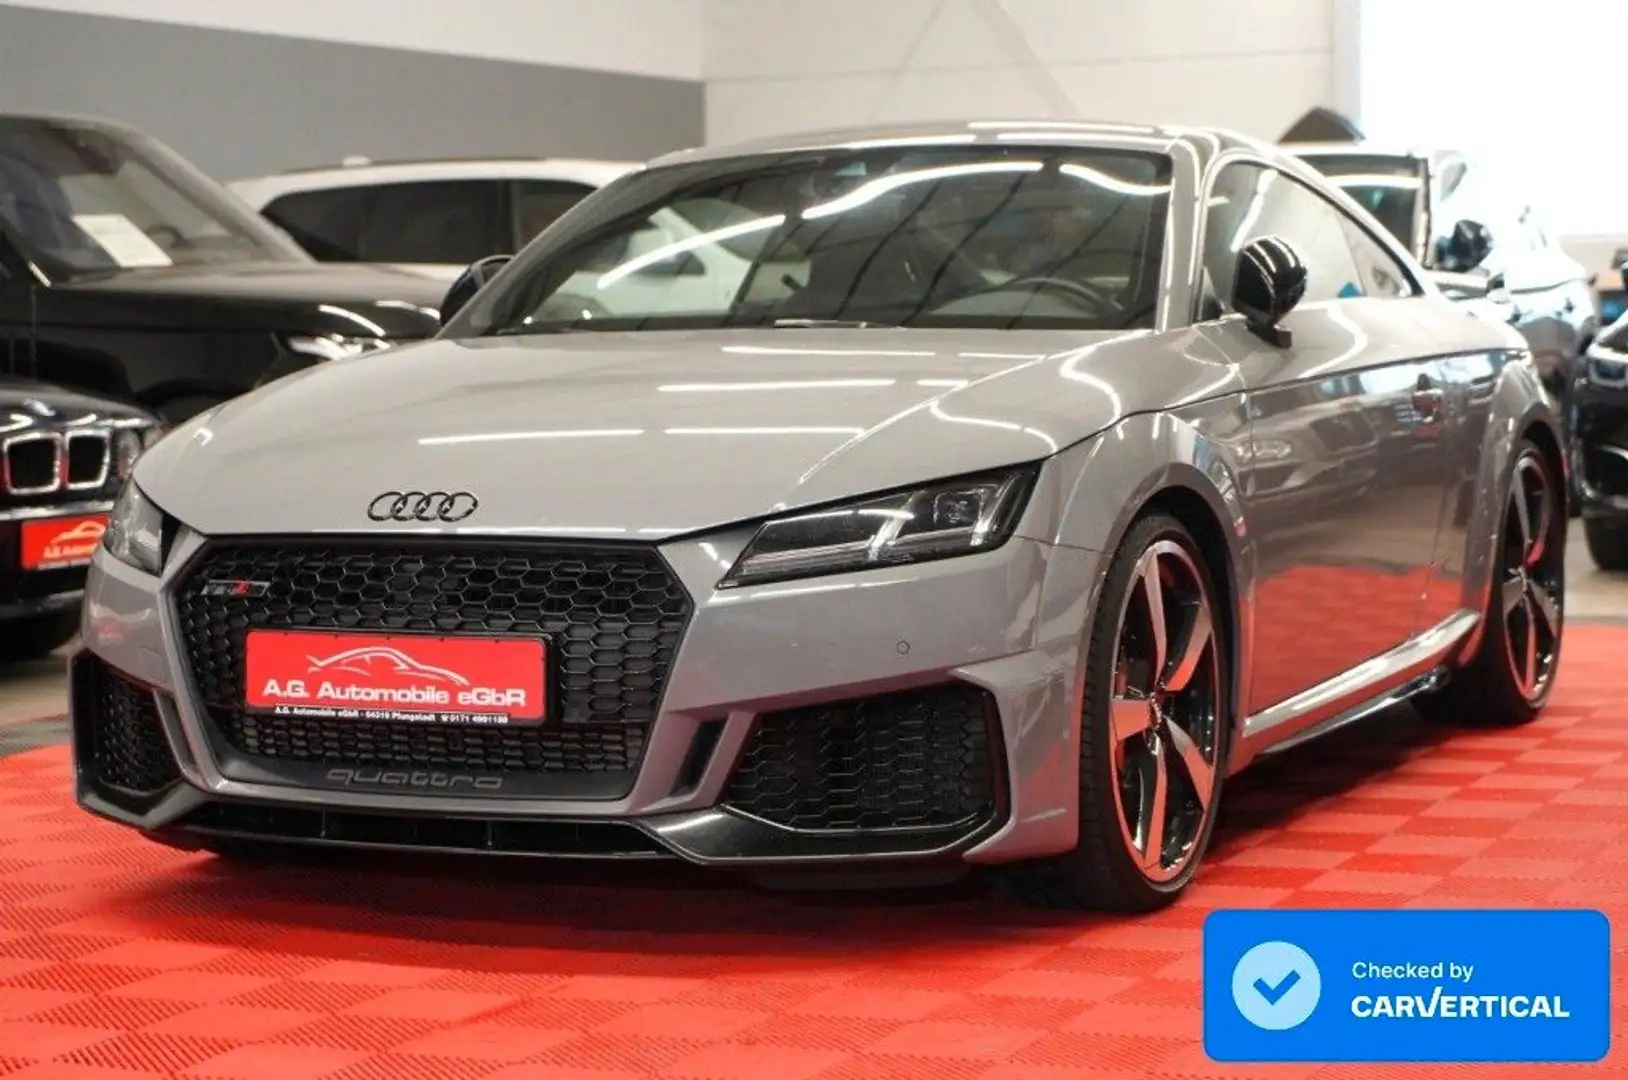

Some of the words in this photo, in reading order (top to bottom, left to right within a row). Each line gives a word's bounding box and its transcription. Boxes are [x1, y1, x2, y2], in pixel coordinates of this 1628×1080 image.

[262, 678, 310, 698] A.G.
[317, 681, 450, 705] Automobile
[457, 686, 526, 707] eGbR
[326, 768, 503, 789] quattro
